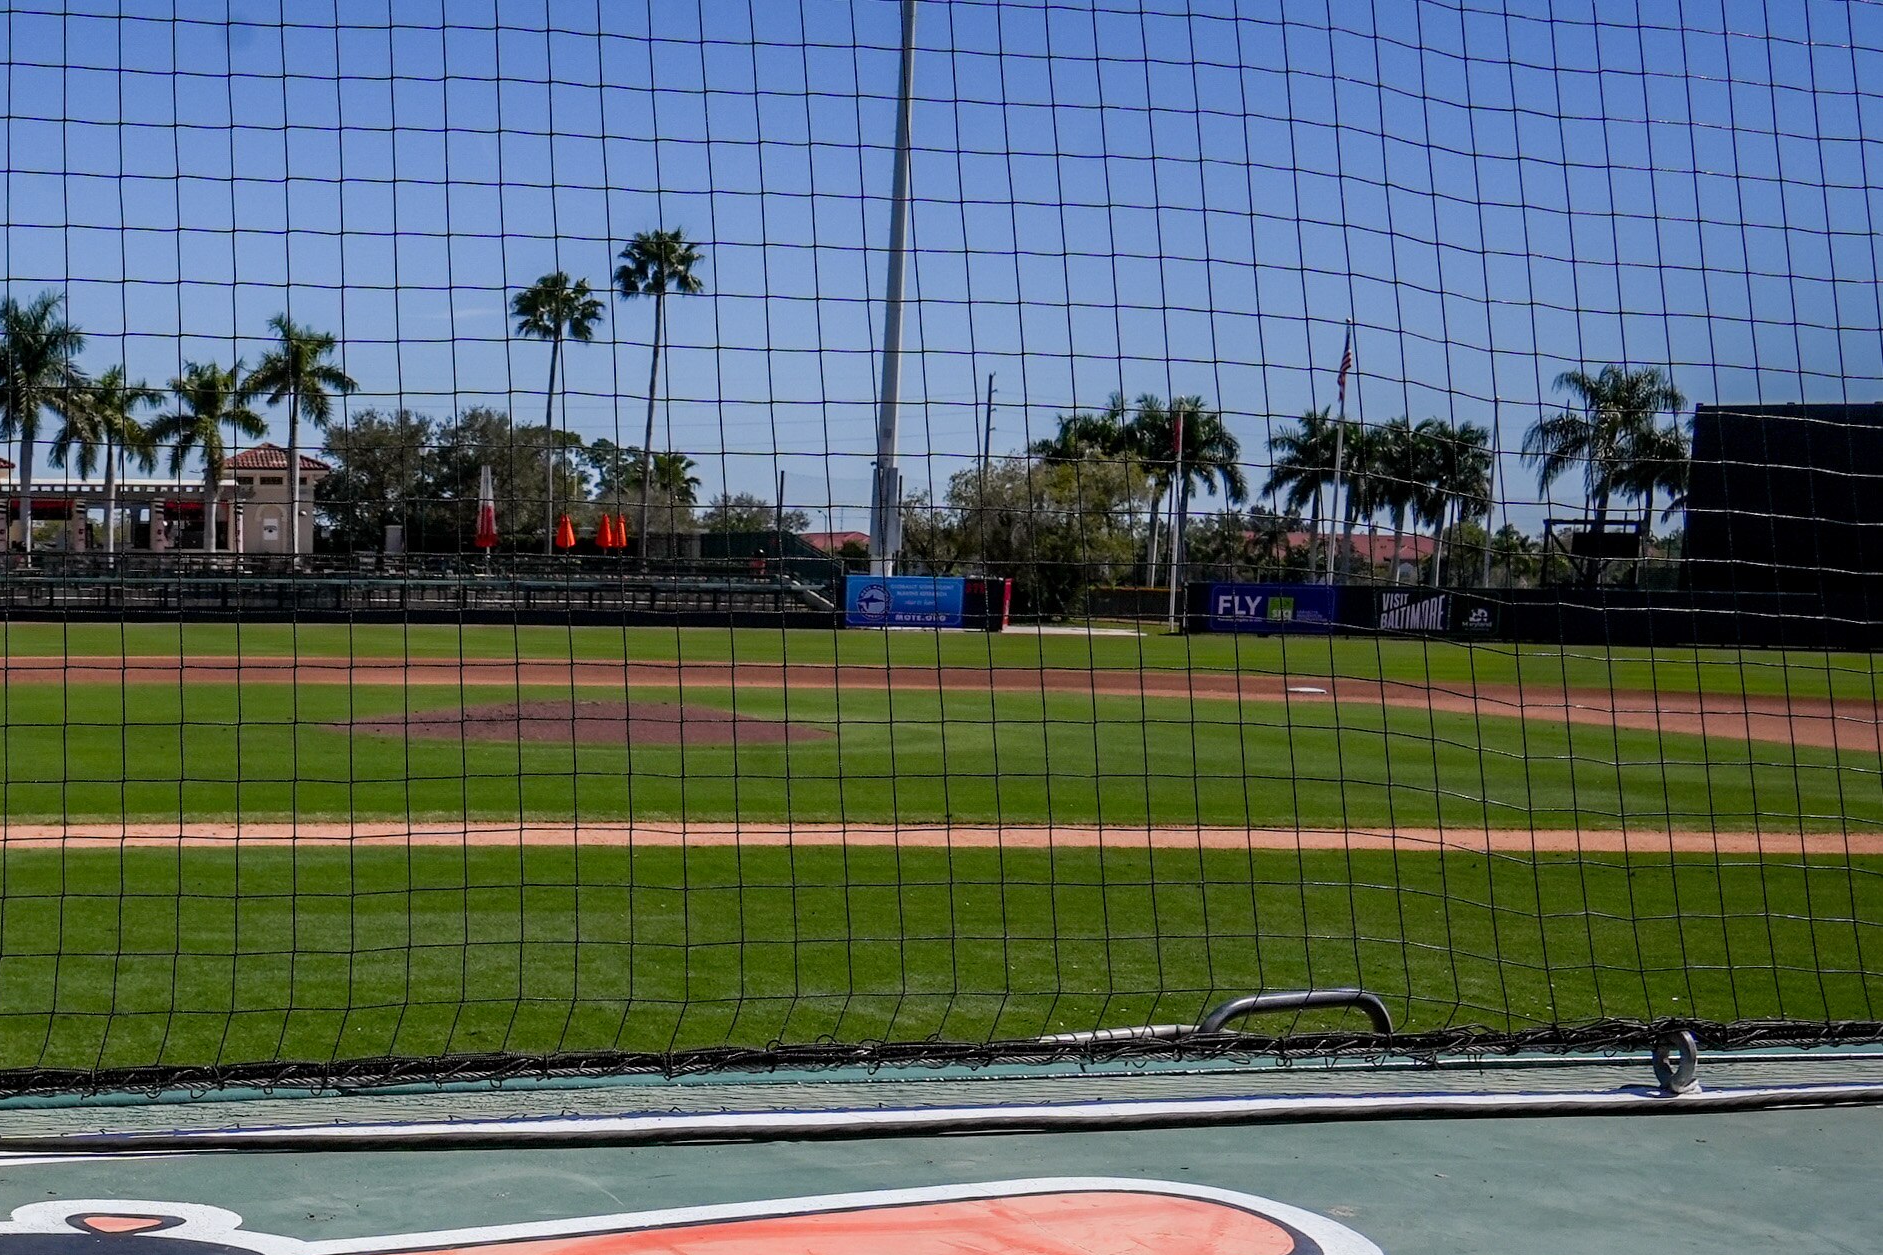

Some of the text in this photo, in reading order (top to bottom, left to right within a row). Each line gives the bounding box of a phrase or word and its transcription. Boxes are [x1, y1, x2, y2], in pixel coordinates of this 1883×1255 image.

[1218, 595, 1262, 615] FLY
[1380, 594, 1446, 630] BALTIMORE
[1382, 593, 1409, 612] VISIT
